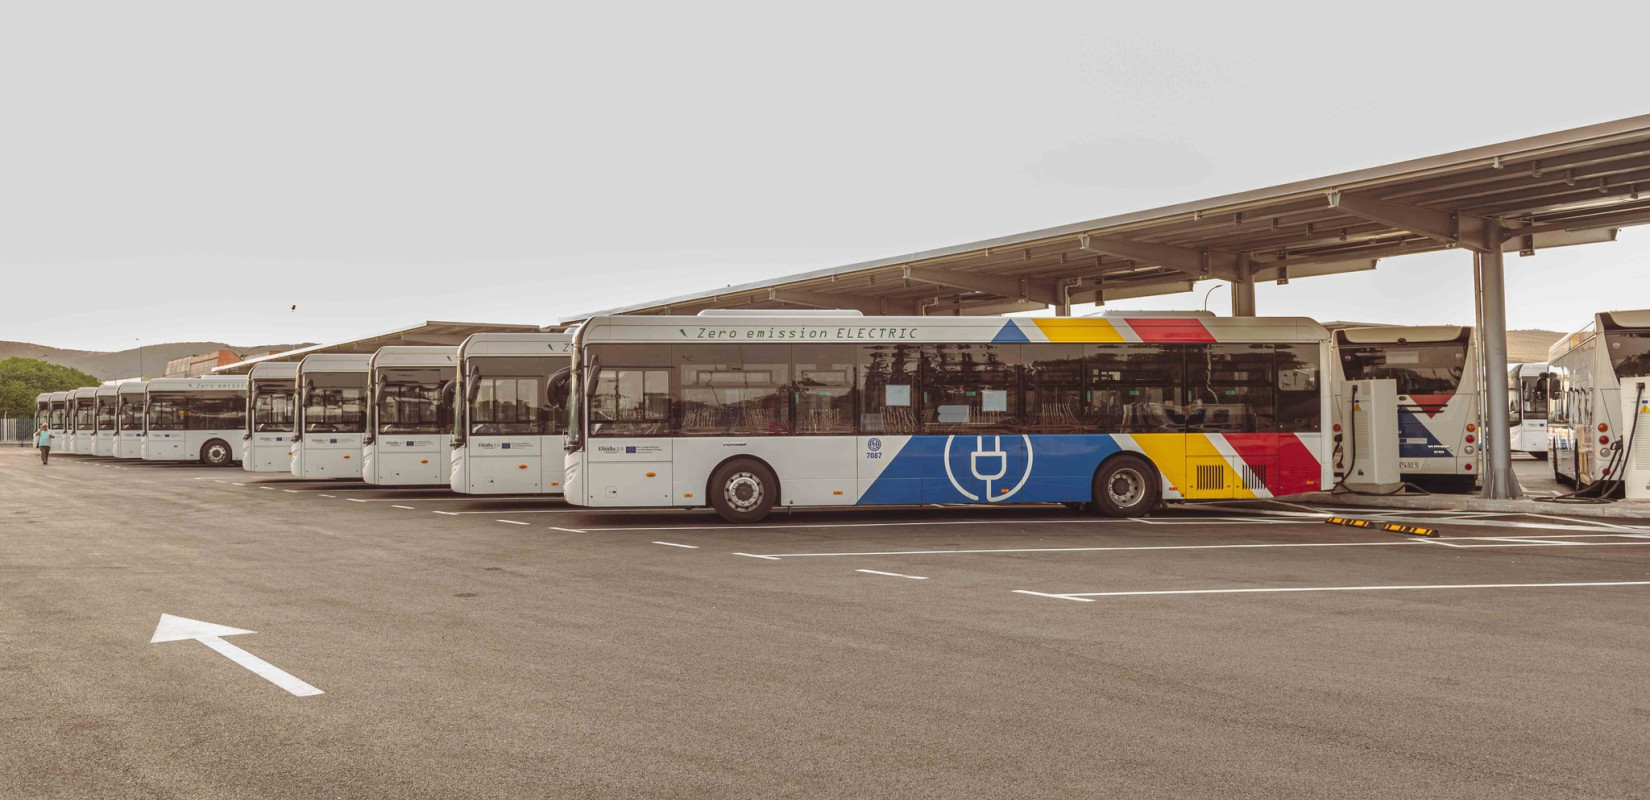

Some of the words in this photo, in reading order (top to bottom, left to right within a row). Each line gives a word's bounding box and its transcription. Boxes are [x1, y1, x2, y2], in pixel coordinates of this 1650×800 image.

[698, 327, 737, 339] Zero
[746, 327, 828, 339] emission
[836, 327, 918, 339] ELECTRIC
